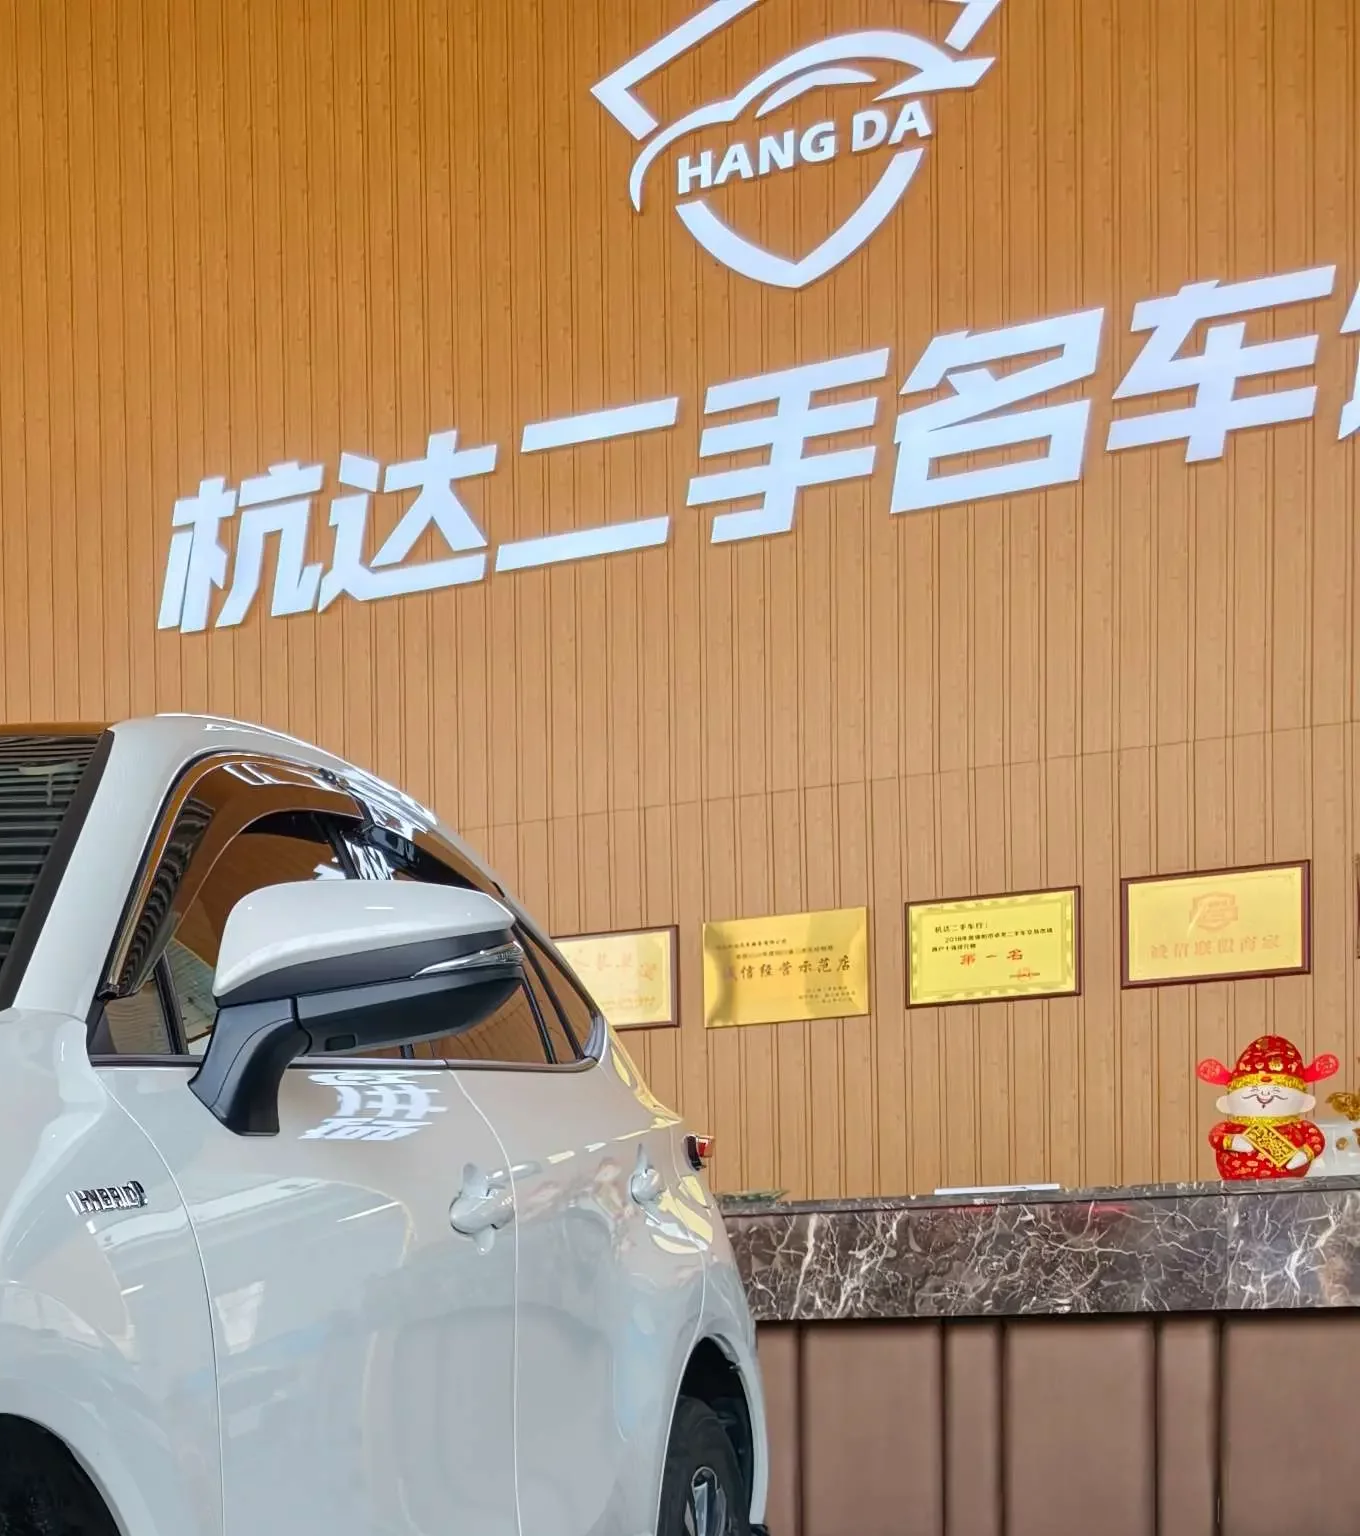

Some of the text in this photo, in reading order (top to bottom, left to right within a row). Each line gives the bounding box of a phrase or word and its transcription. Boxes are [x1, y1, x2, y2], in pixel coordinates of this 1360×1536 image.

[677, 100, 932, 194] HANG DA
[157, 264, 1360, 634] 杭达二手名车
